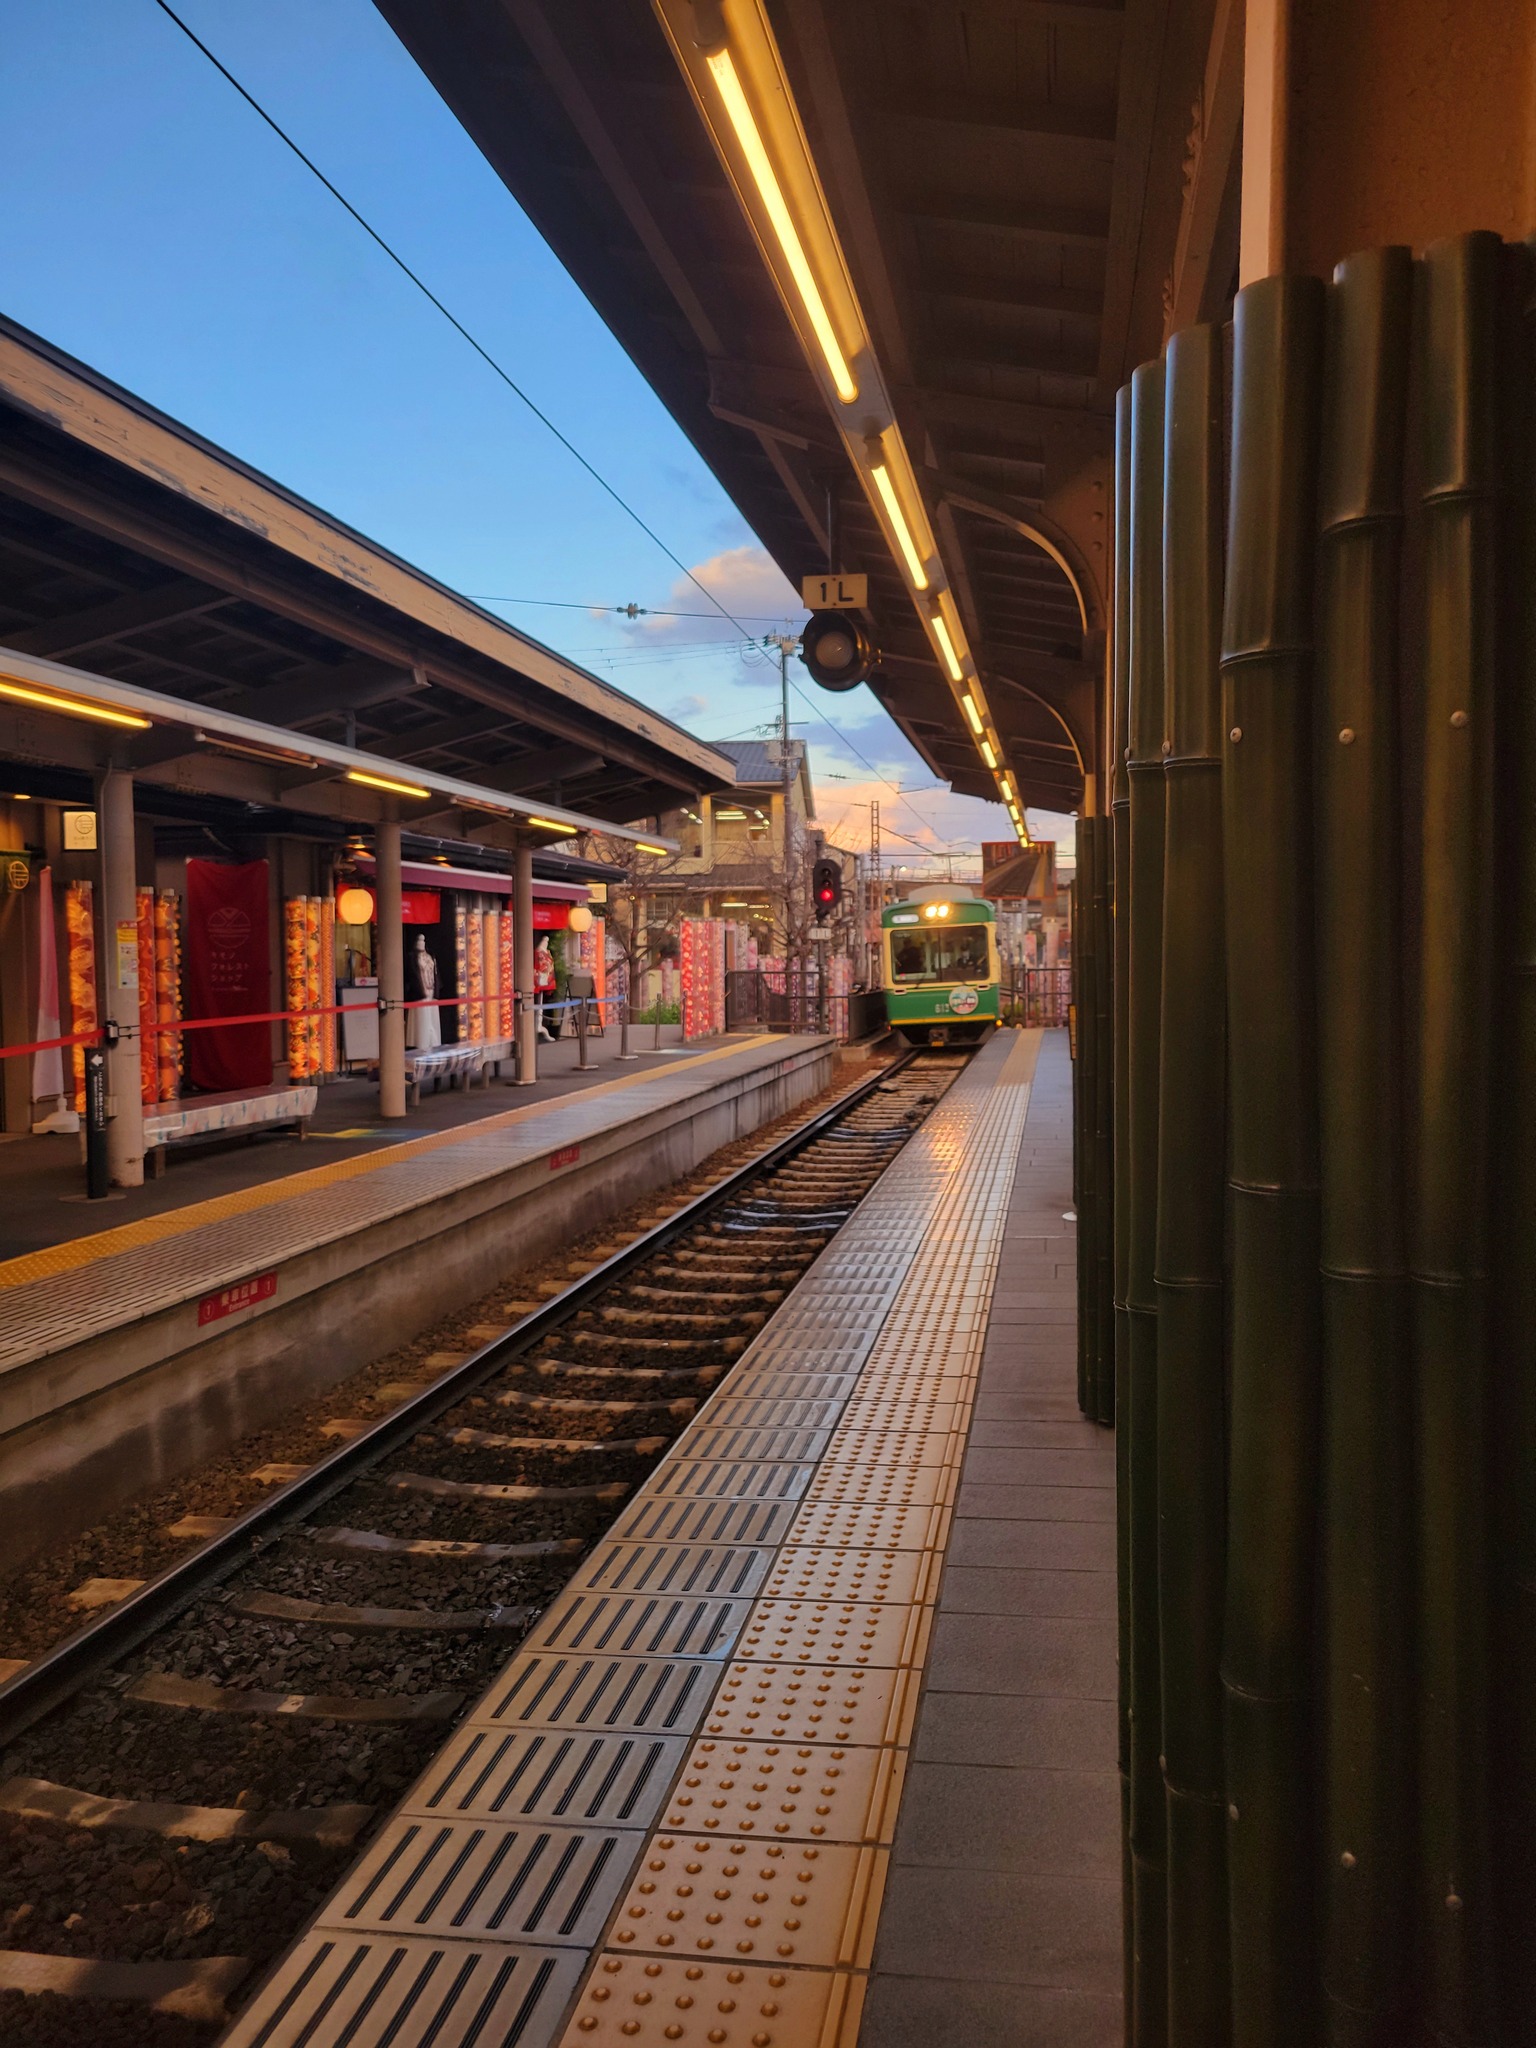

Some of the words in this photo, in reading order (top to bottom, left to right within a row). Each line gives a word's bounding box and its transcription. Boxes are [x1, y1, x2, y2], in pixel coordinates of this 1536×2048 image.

[820, 581, 854, 603] 1L
[211, 951, 236, 960] キモノ
[211, 962, 250, 971] フォレスト
